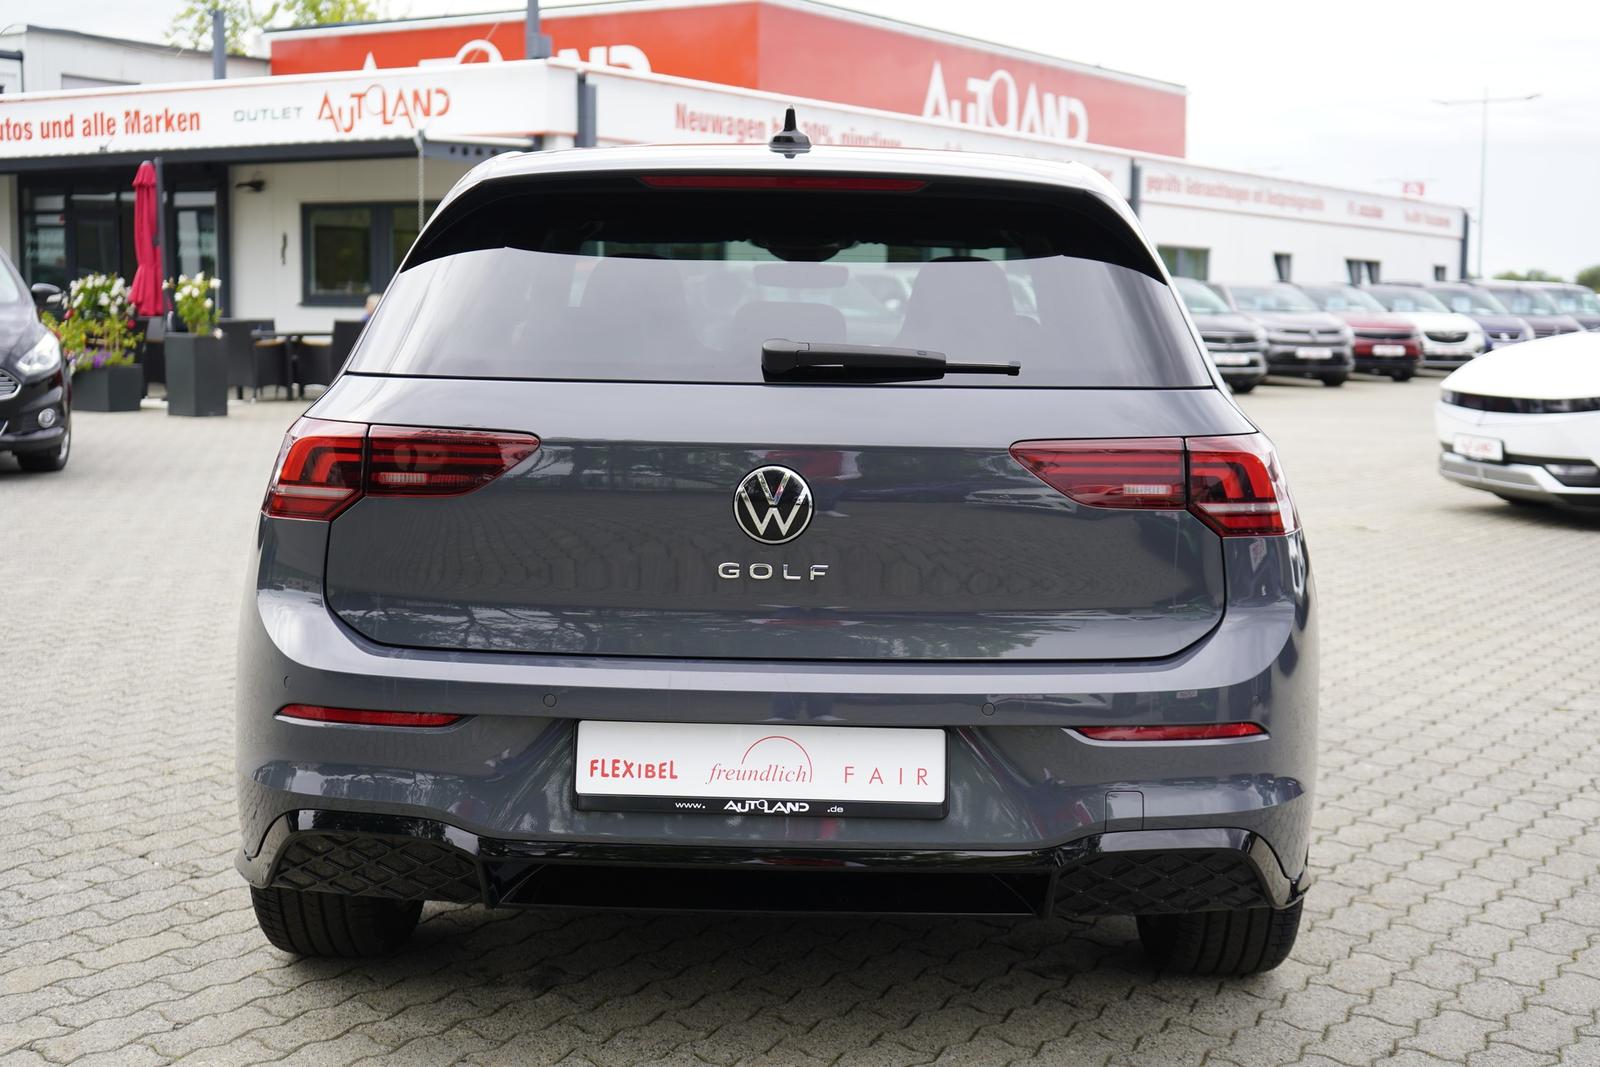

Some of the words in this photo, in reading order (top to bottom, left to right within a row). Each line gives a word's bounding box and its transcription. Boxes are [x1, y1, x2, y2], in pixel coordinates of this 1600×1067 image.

[40, 114, 74, 139] und
[82, 111, 117, 137] alle
[124, 107, 201, 135] Marken
[233, 106, 304, 123] OUTLET
[673, 101, 766, 144] Neuwagen
[717, 562, 830, 581] GOLF
[589, 758, 679, 780] FLEXIBEL
[705, 763, 808, 786] freundlich
[843, 766, 929, 786] FAIR
